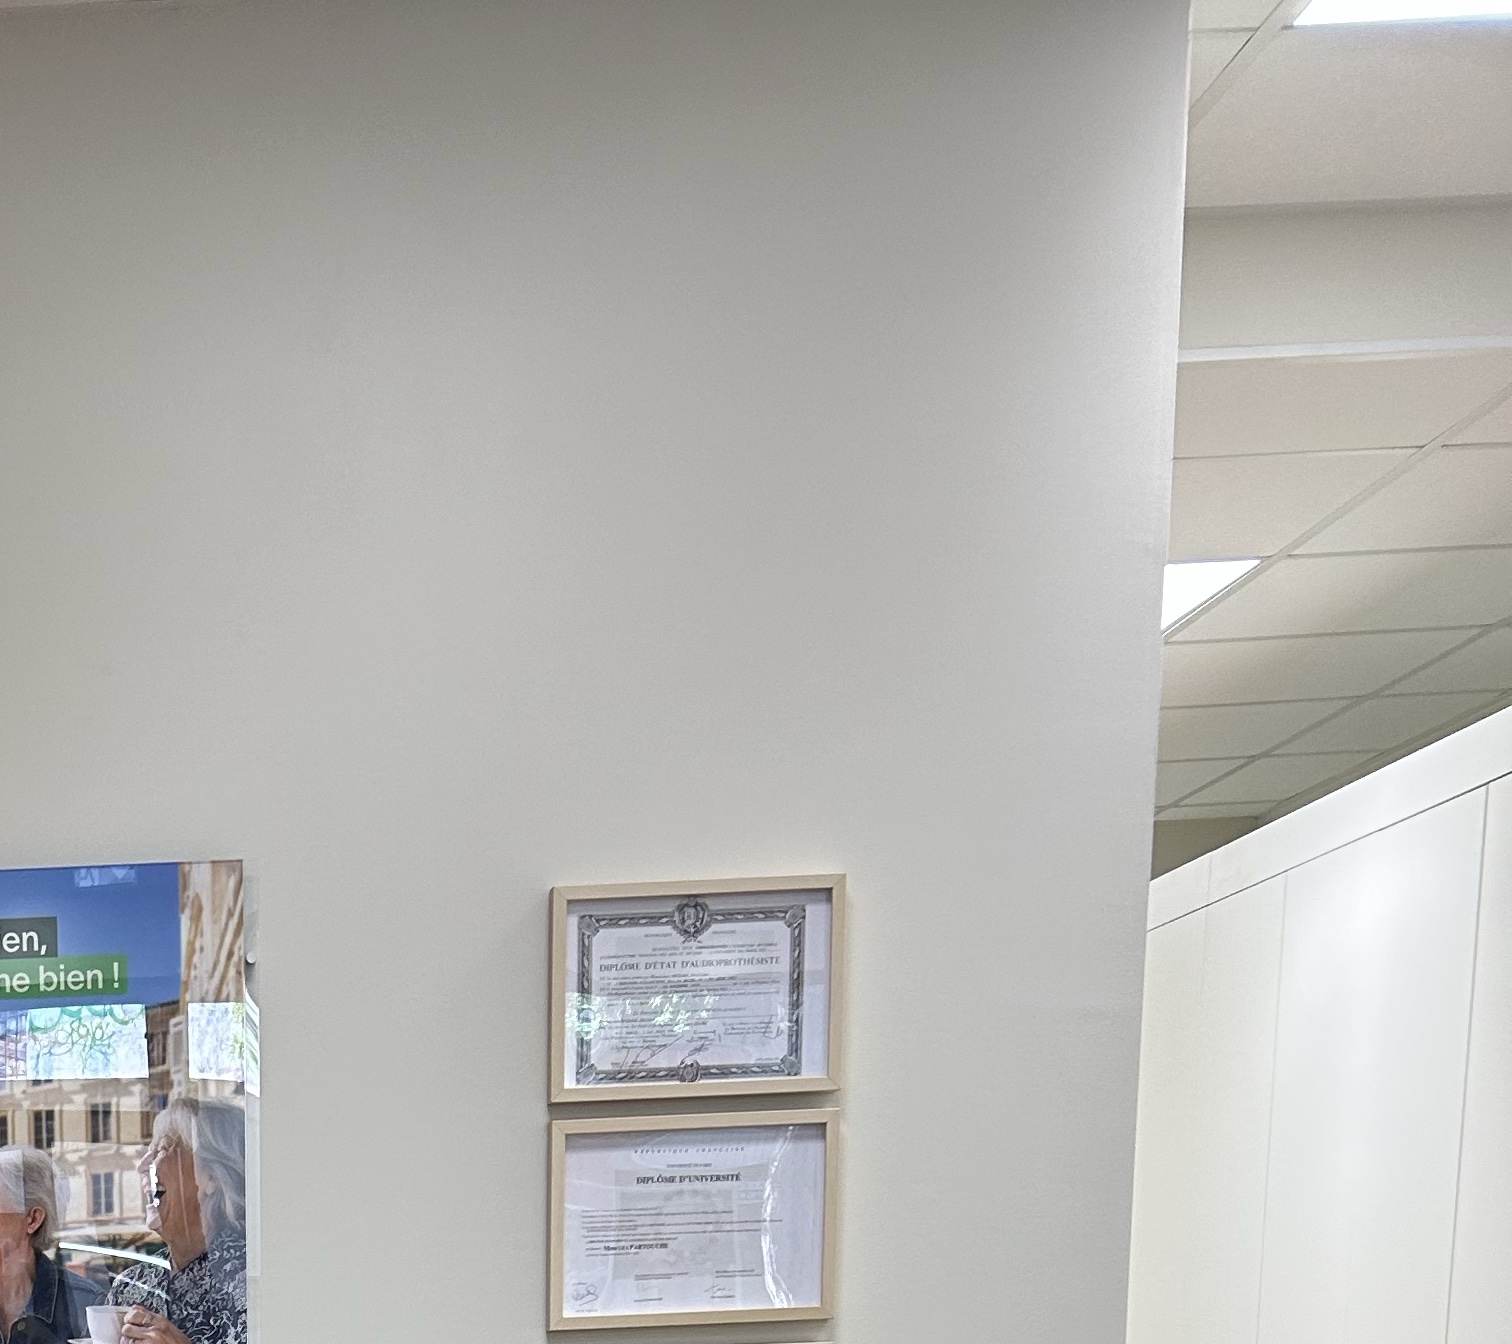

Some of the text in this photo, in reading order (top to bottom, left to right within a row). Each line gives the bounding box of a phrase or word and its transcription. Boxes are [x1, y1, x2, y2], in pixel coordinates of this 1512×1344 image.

[644, 960, 678, 970] D'ÉTAT
[39, 964, 104, 992] bien
[112, 962, 120, 988] !
[636, 1172, 742, 1185] DIPLÔME D'UNIVERSITÉ
